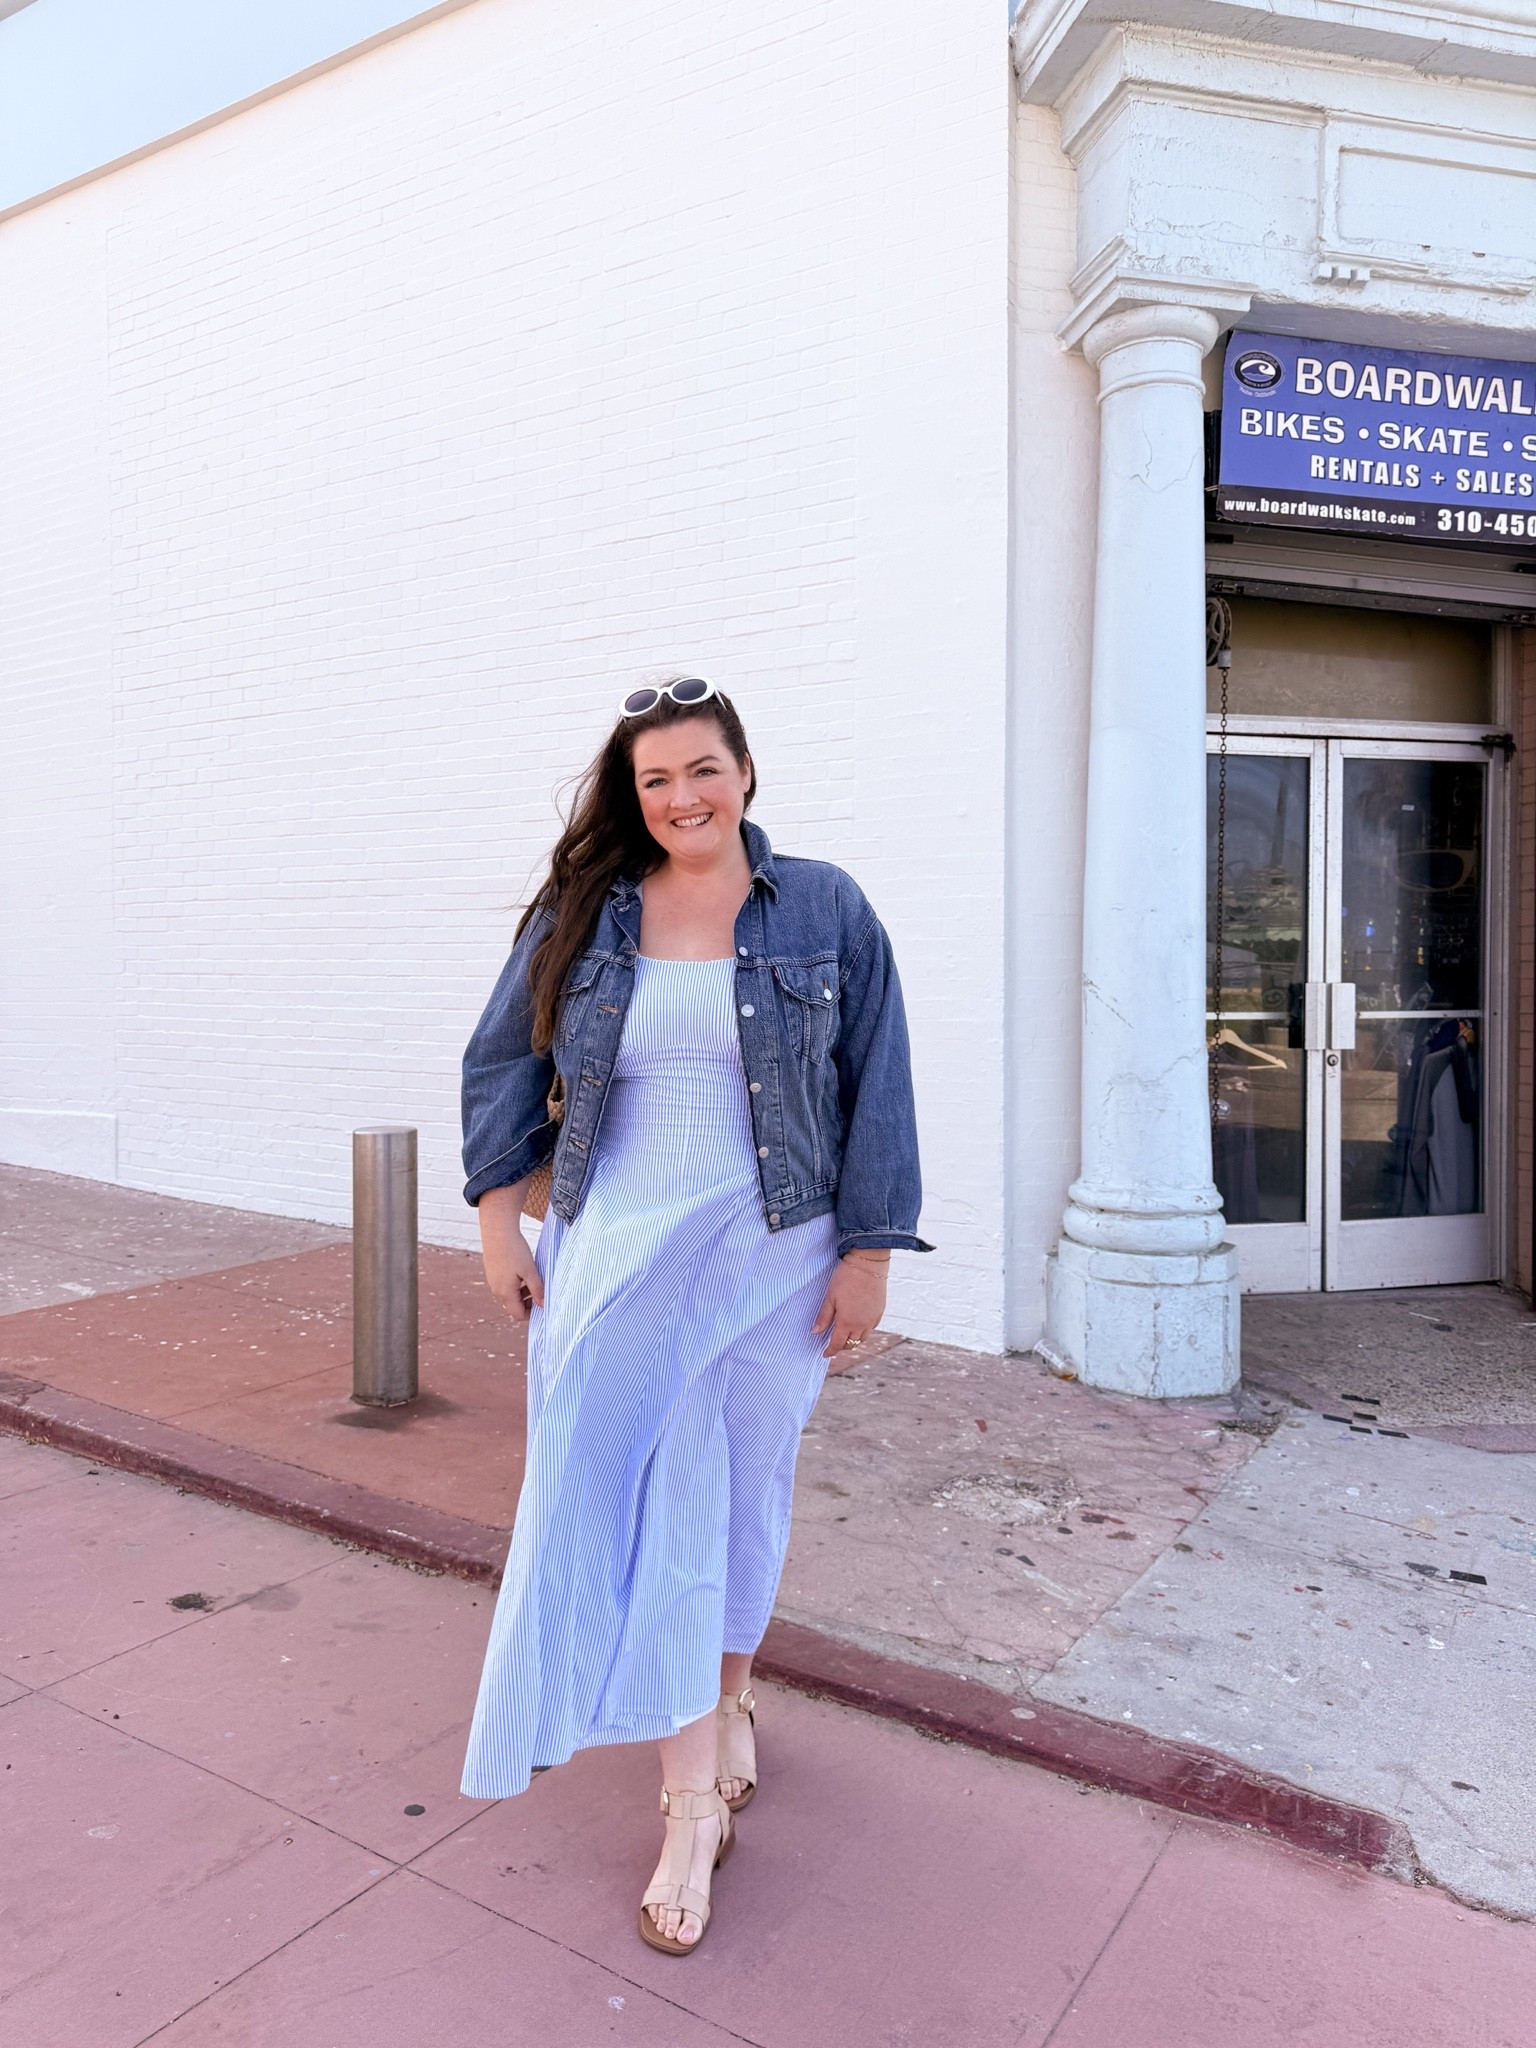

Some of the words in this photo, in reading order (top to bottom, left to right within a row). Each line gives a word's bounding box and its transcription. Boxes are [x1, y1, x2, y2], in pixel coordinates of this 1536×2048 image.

[1296, 358, 1536, 415] BOARDWAL
[1240, 409, 1345, 443] BIKES
[1379, 423, 1490, 457] SKATE
[1310, 455, 1420, 487] RENTALS
[1456, 468, 1533, 496] SALES
[1224, 498, 1416, 526] www.boardwalkskate.com
